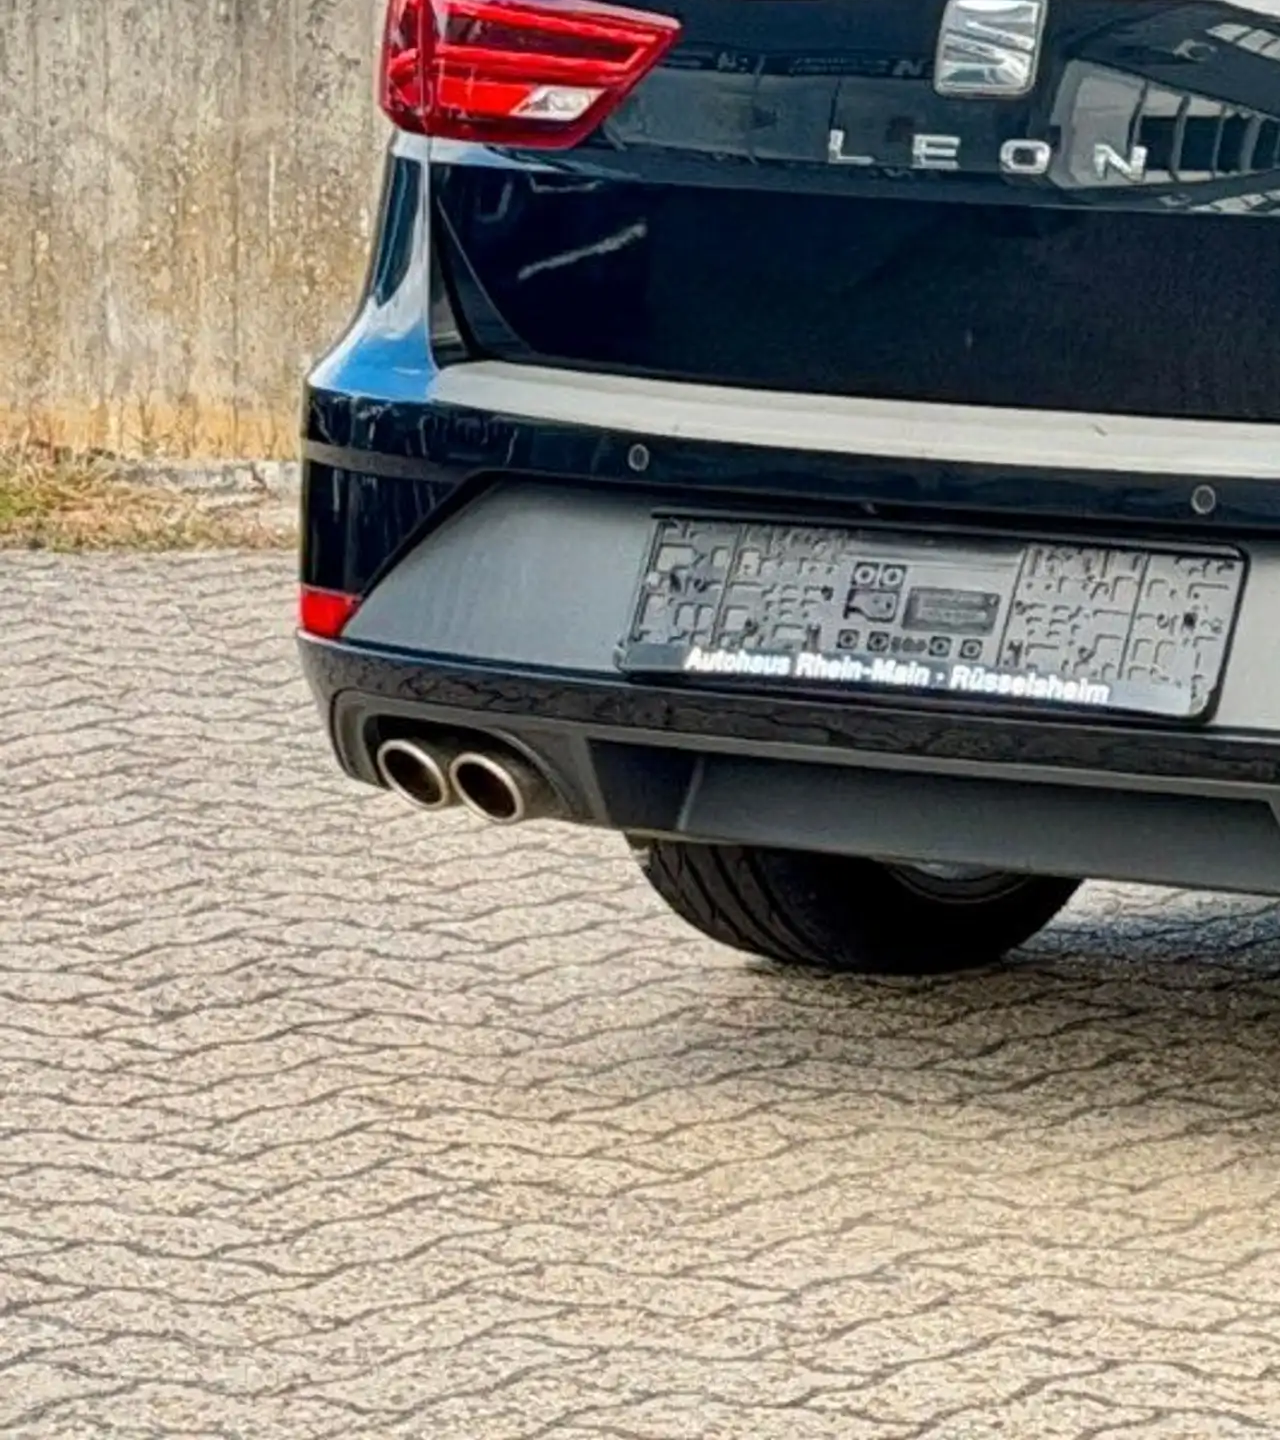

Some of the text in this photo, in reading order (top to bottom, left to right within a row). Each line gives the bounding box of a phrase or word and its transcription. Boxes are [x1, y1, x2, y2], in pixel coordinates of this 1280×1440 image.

[828, 128, 1147, 183] LEON
[684, 646, 1111, 705] Autohaus Rhein-Main Rüsselsheim
